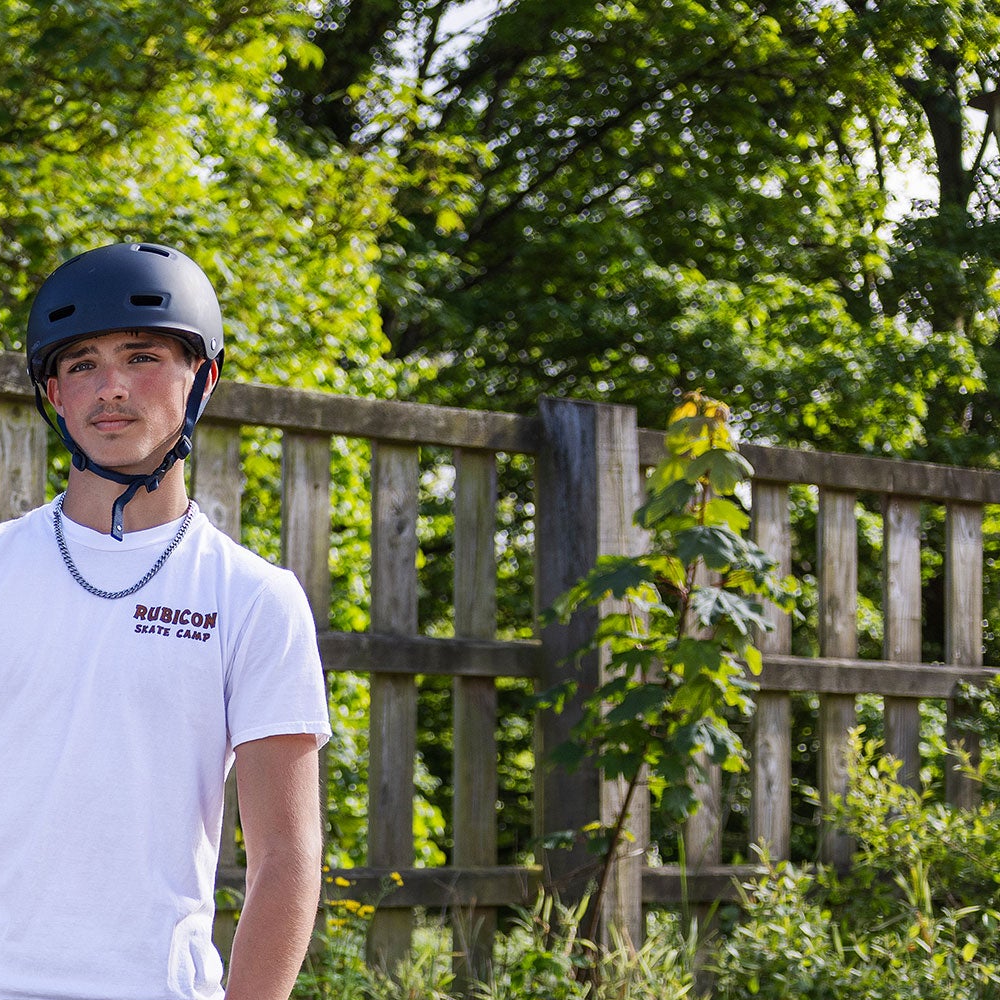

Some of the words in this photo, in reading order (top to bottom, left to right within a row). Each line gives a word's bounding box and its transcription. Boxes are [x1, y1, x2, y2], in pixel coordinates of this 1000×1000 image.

[133, 604, 218, 629] RUBICON
[134, 624, 171, 637] SKATE
[176, 629, 211, 642] CAMP
